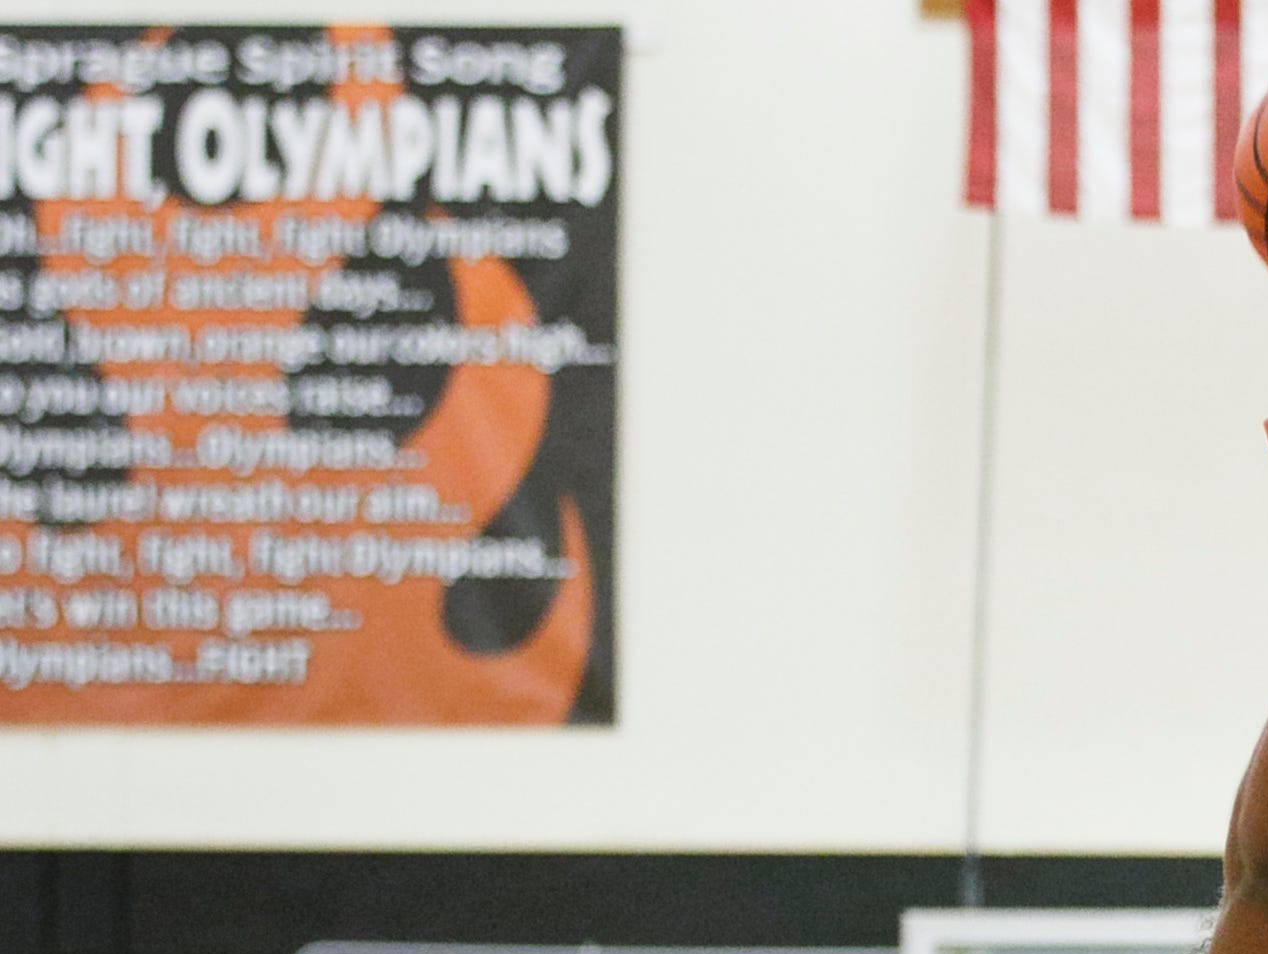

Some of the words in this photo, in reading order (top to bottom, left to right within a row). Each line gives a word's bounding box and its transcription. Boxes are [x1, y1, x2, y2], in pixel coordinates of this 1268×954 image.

[236, 36, 400, 92] Spirit
[410, 40, 567, 94] Song
[175, 87, 612, 207] OLYMPIANS
[369, 212, 569, 266] Olympians
[122, 271, 165, 310] of
[169, 271, 307, 311] ancient
[100, 374, 166, 415] our
[292, 482, 358, 523] our
[63, 584, 138, 630] win
[141, 584, 219, 630] this
